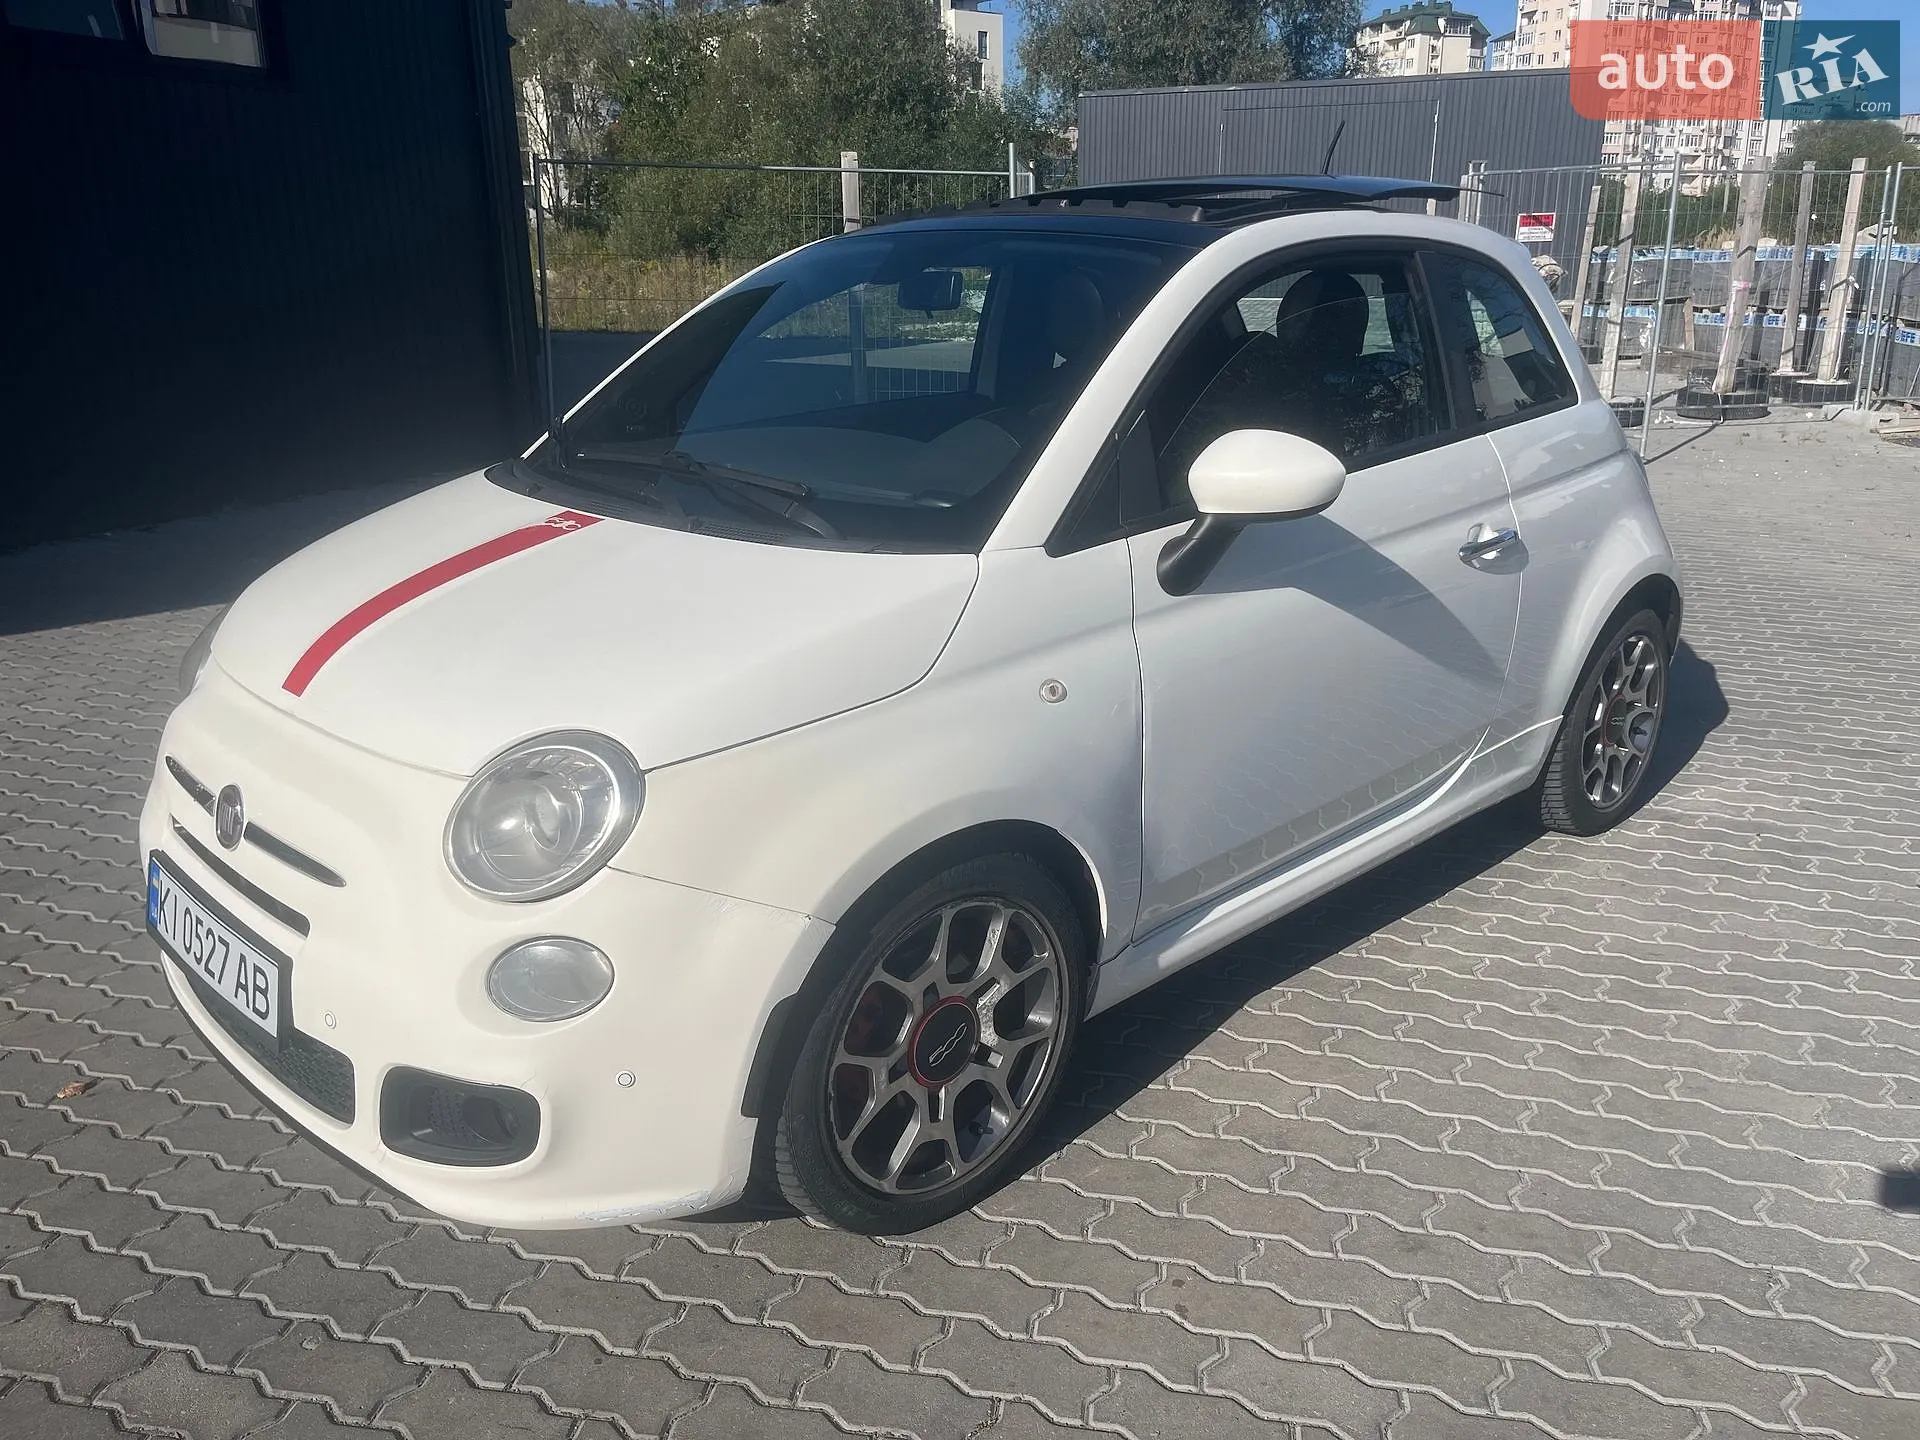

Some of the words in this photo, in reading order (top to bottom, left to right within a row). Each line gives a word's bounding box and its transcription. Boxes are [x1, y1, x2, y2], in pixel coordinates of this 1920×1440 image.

[159, 879, 178, 941] KI
[183, 906, 231, 985] 0527
[234, 952, 270, 1020] AB
